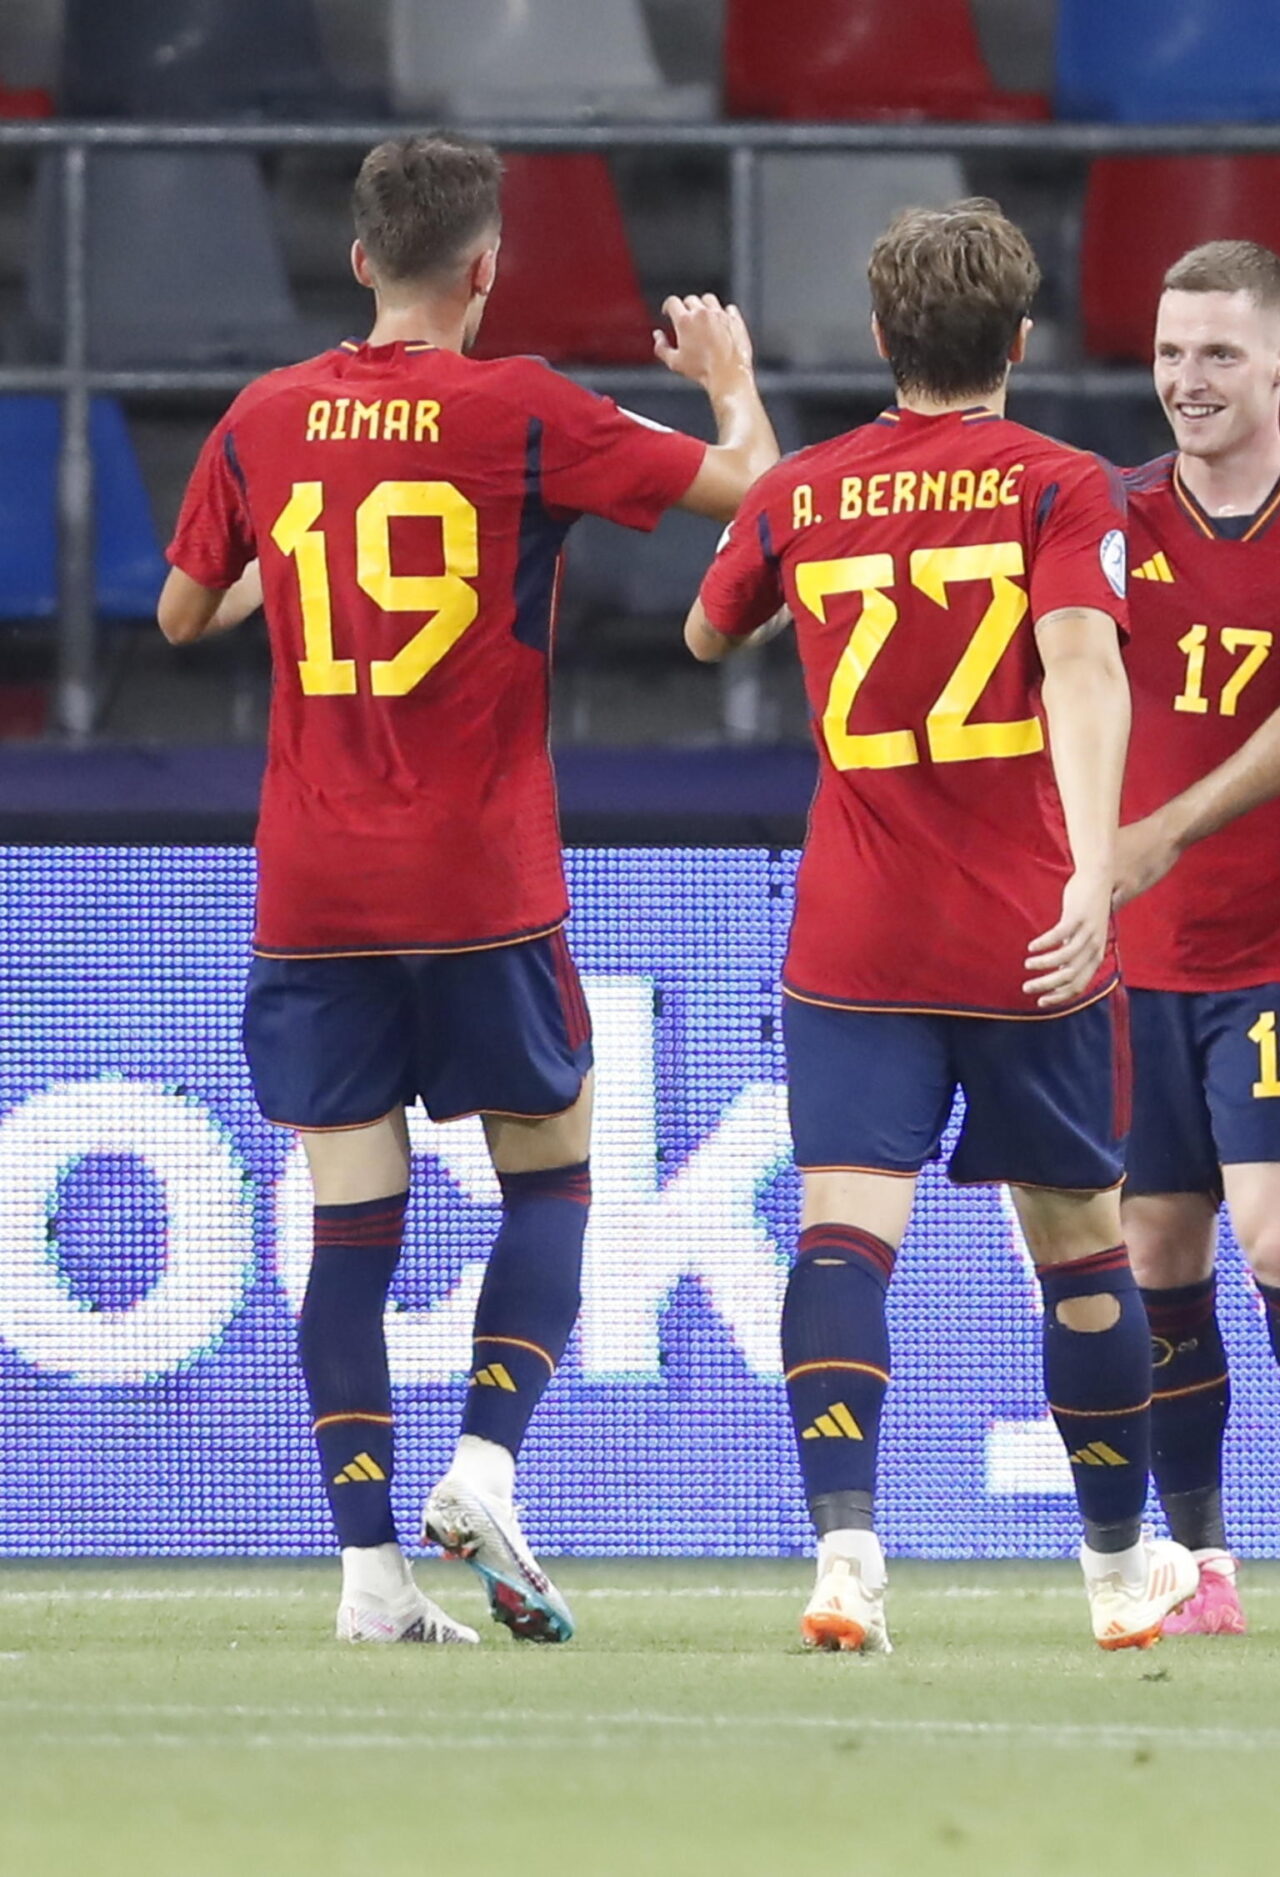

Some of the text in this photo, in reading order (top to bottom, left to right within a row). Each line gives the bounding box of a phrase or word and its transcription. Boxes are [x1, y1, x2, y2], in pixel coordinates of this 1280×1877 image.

[305, 398, 441, 443] AIMAR
[792, 484, 822, 530] A.
[271, 480, 478, 696] 19
[795, 541, 1044, 771] 22
[1174, 623, 1273, 716] 17
